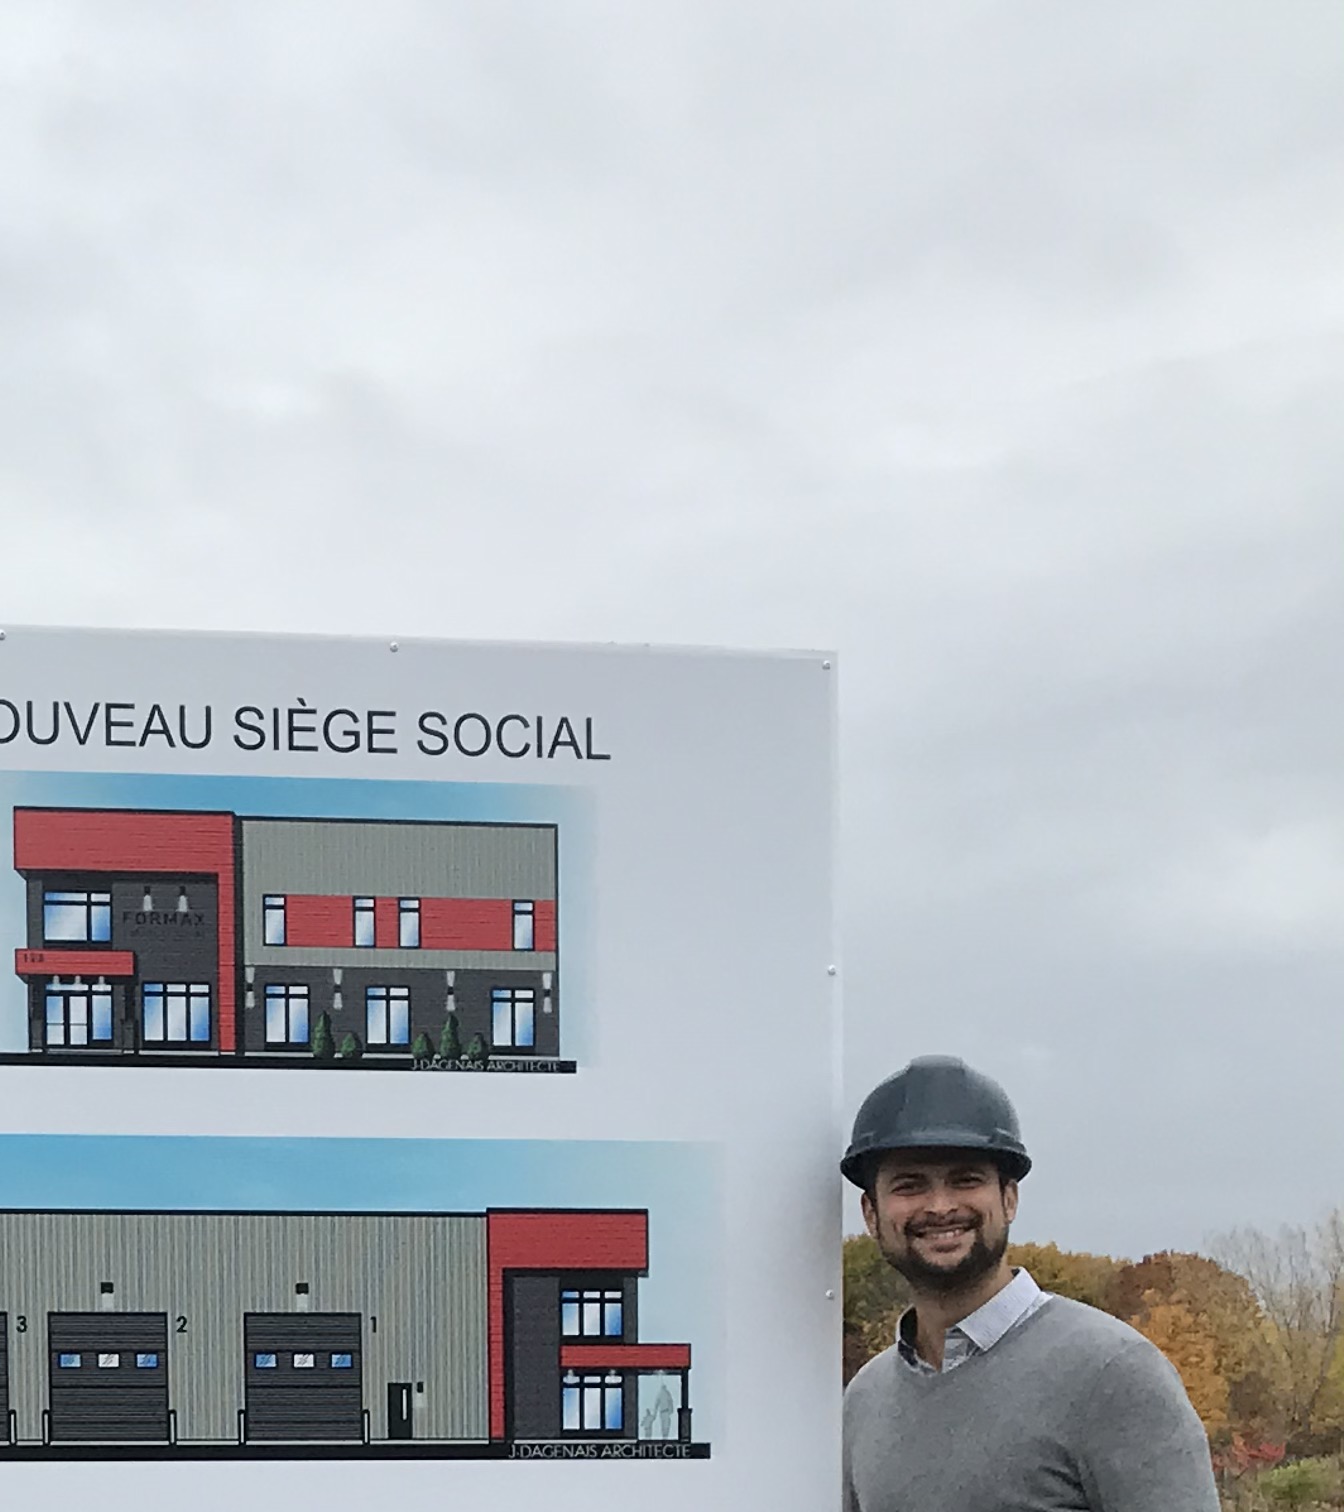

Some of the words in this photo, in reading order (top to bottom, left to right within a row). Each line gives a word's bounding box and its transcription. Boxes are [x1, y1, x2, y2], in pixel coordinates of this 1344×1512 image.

[233, 697, 399, 755] SIÈGE
[417, 711, 612, 761] SOCIAL
[486, 1060, 561, 1073] ARCHITECTE
[16, 1315, 29, 1334] 3
[176, 1315, 188, 1334] 2
[370, 1316, 378, 1334] 1
[601, 1444, 692, 1459] ARCHITECTE
